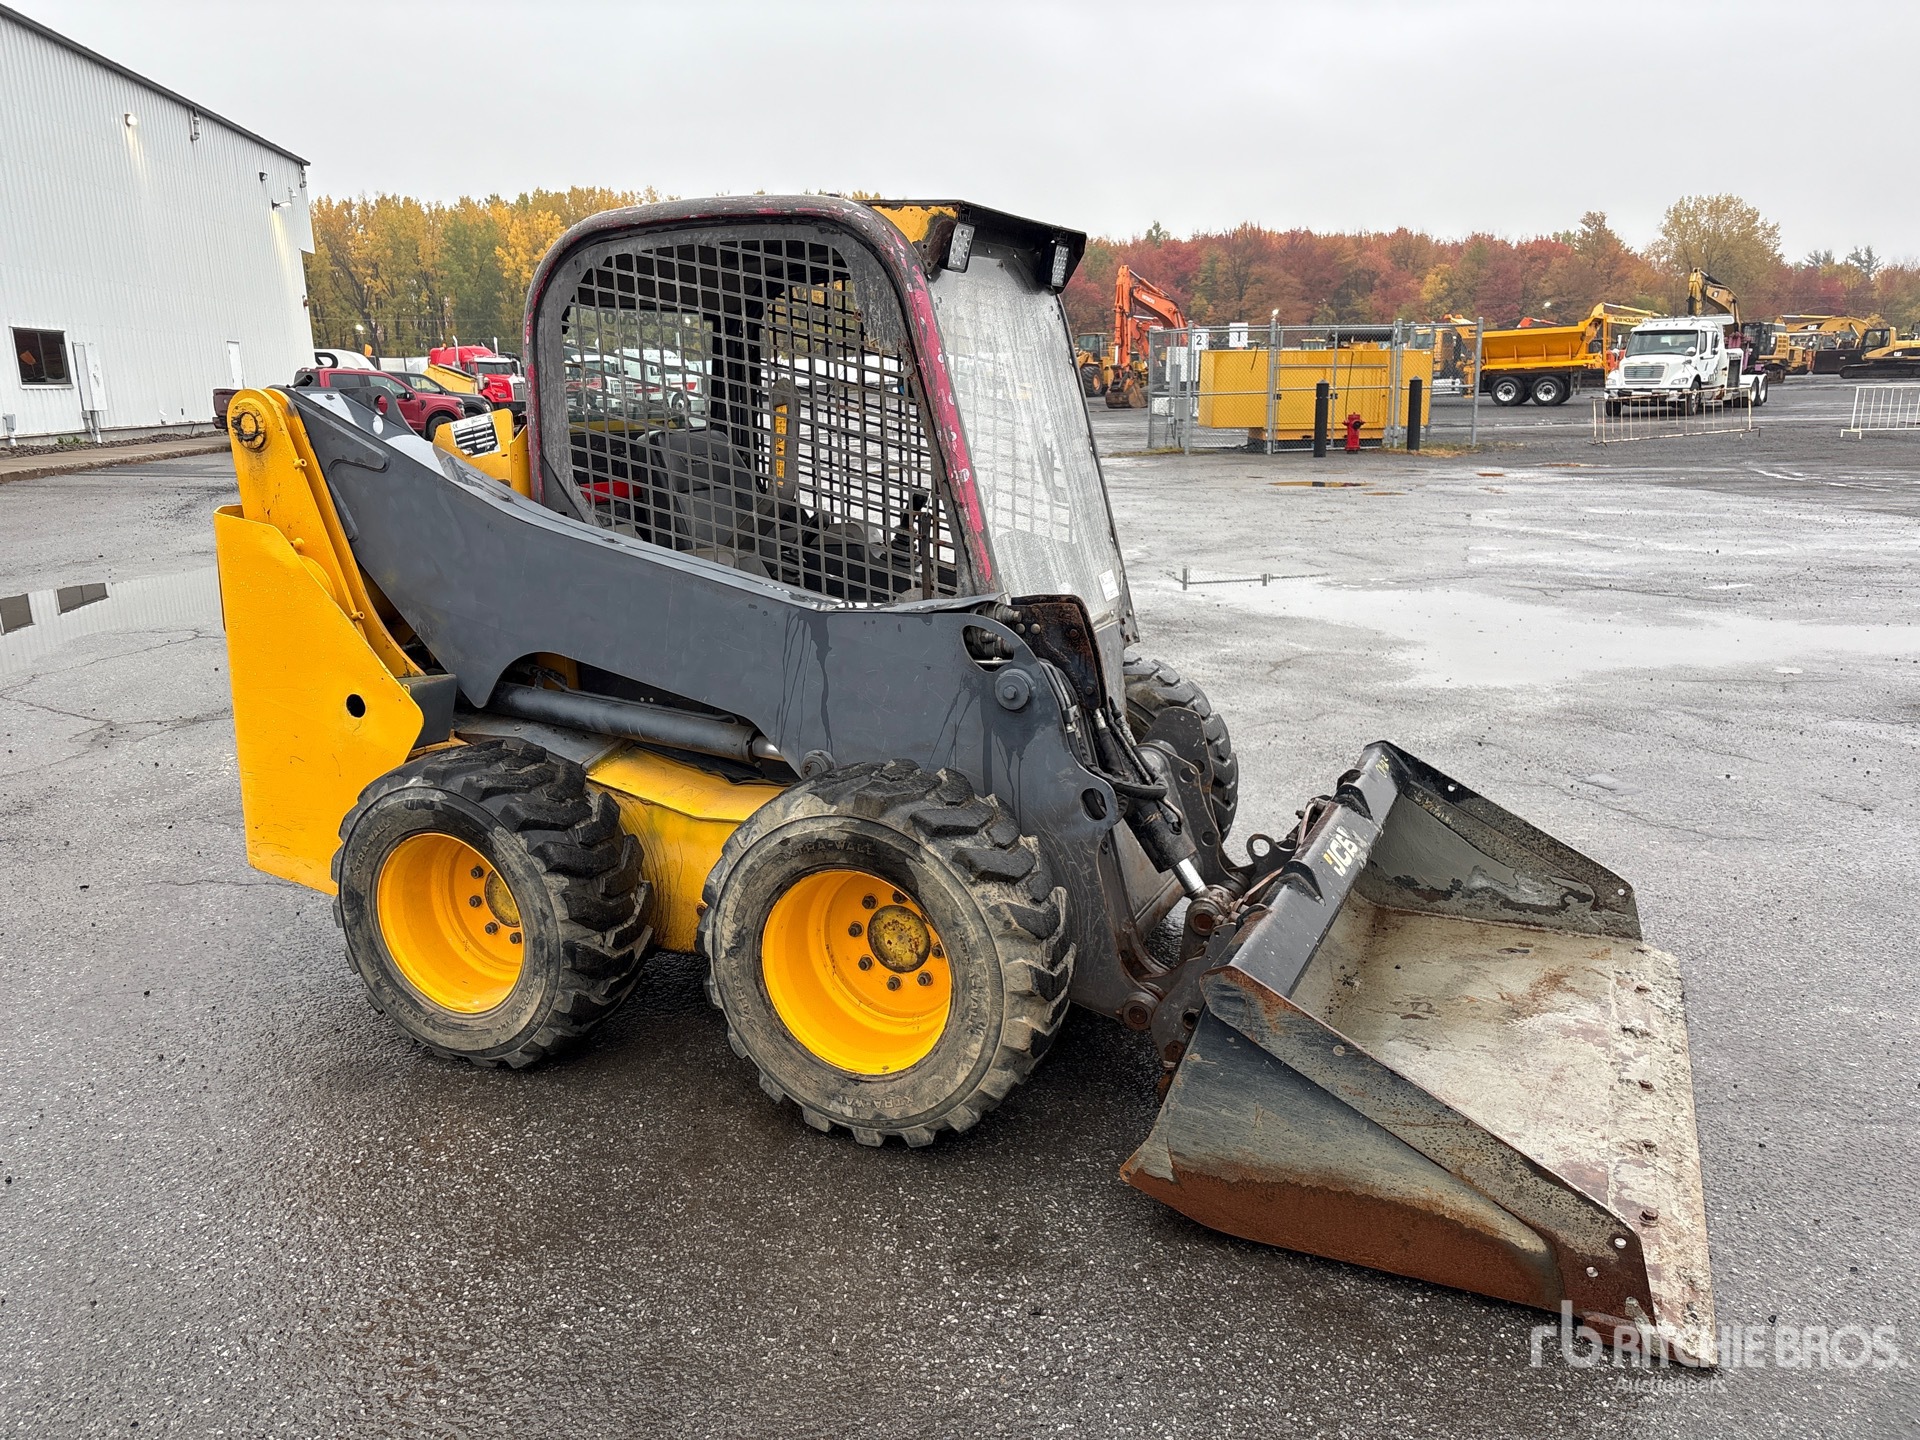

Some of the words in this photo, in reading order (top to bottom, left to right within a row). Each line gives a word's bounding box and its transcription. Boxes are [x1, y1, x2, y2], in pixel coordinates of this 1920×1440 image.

[1196, 334, 1202, 346] 2
[1323, 826, 1358, 877] JCB
[833, 1094, 914, 1109] XTRA-WAL
